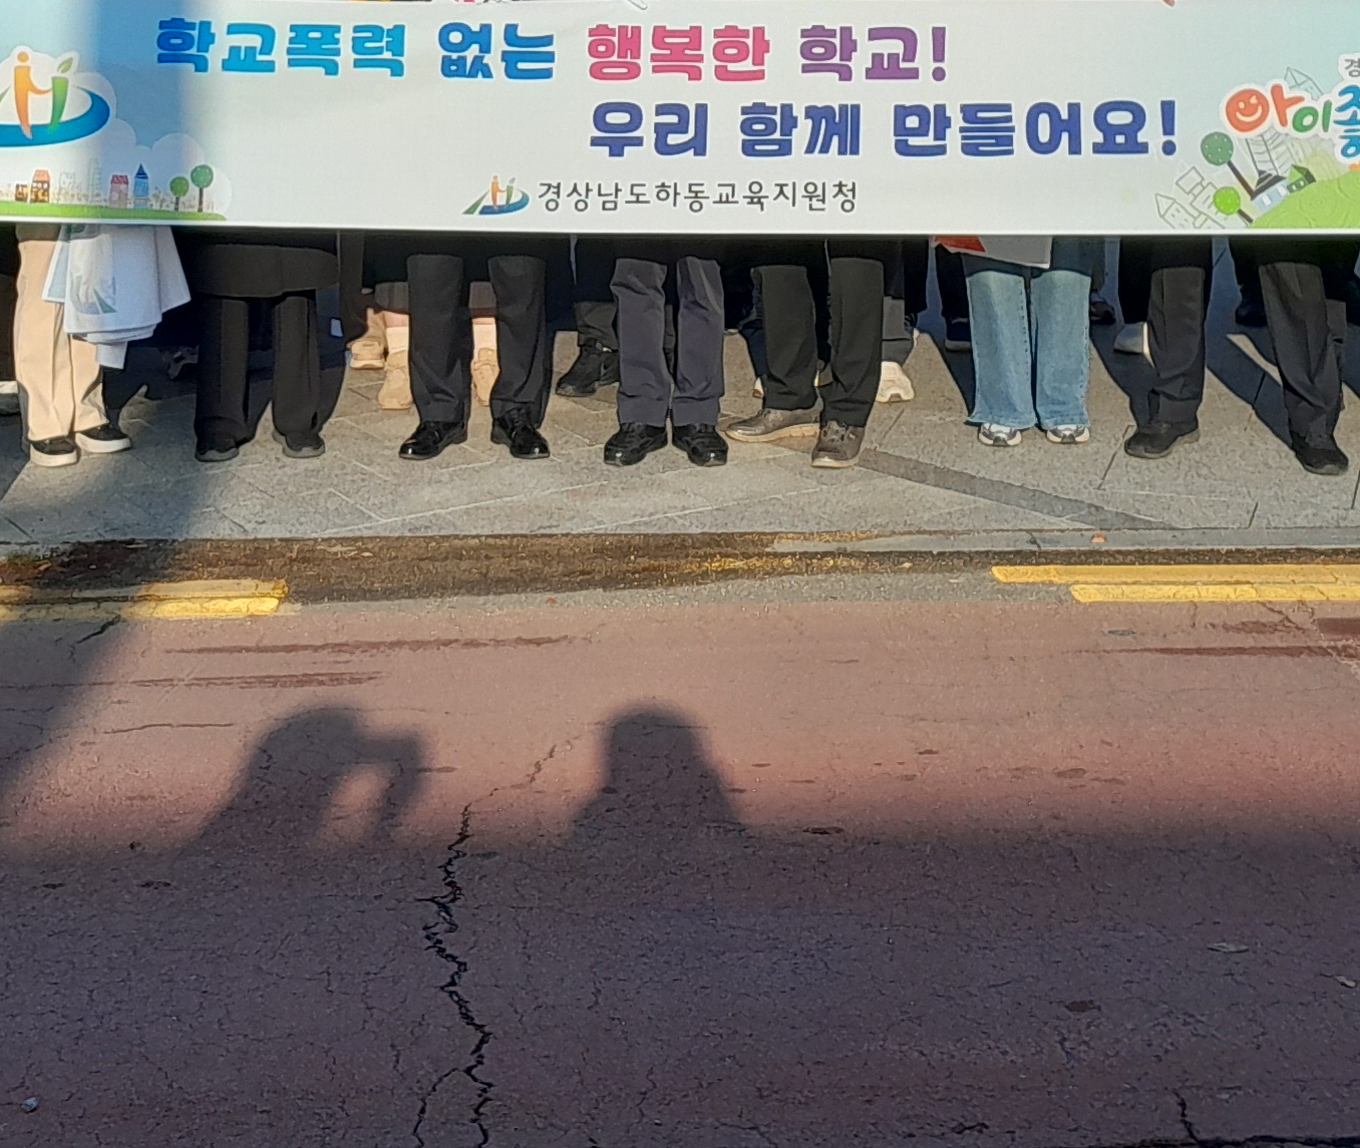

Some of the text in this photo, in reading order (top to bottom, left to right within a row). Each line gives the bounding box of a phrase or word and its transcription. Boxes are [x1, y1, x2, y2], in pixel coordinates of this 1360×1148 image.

[157, 18, 948, 83] 학교폭력 없는 행복한 학교!
[590, 99, 1179, 159] 우리 함께 만들어요!
[538, 179, 858, 215] 경상남도하동교육지원청
